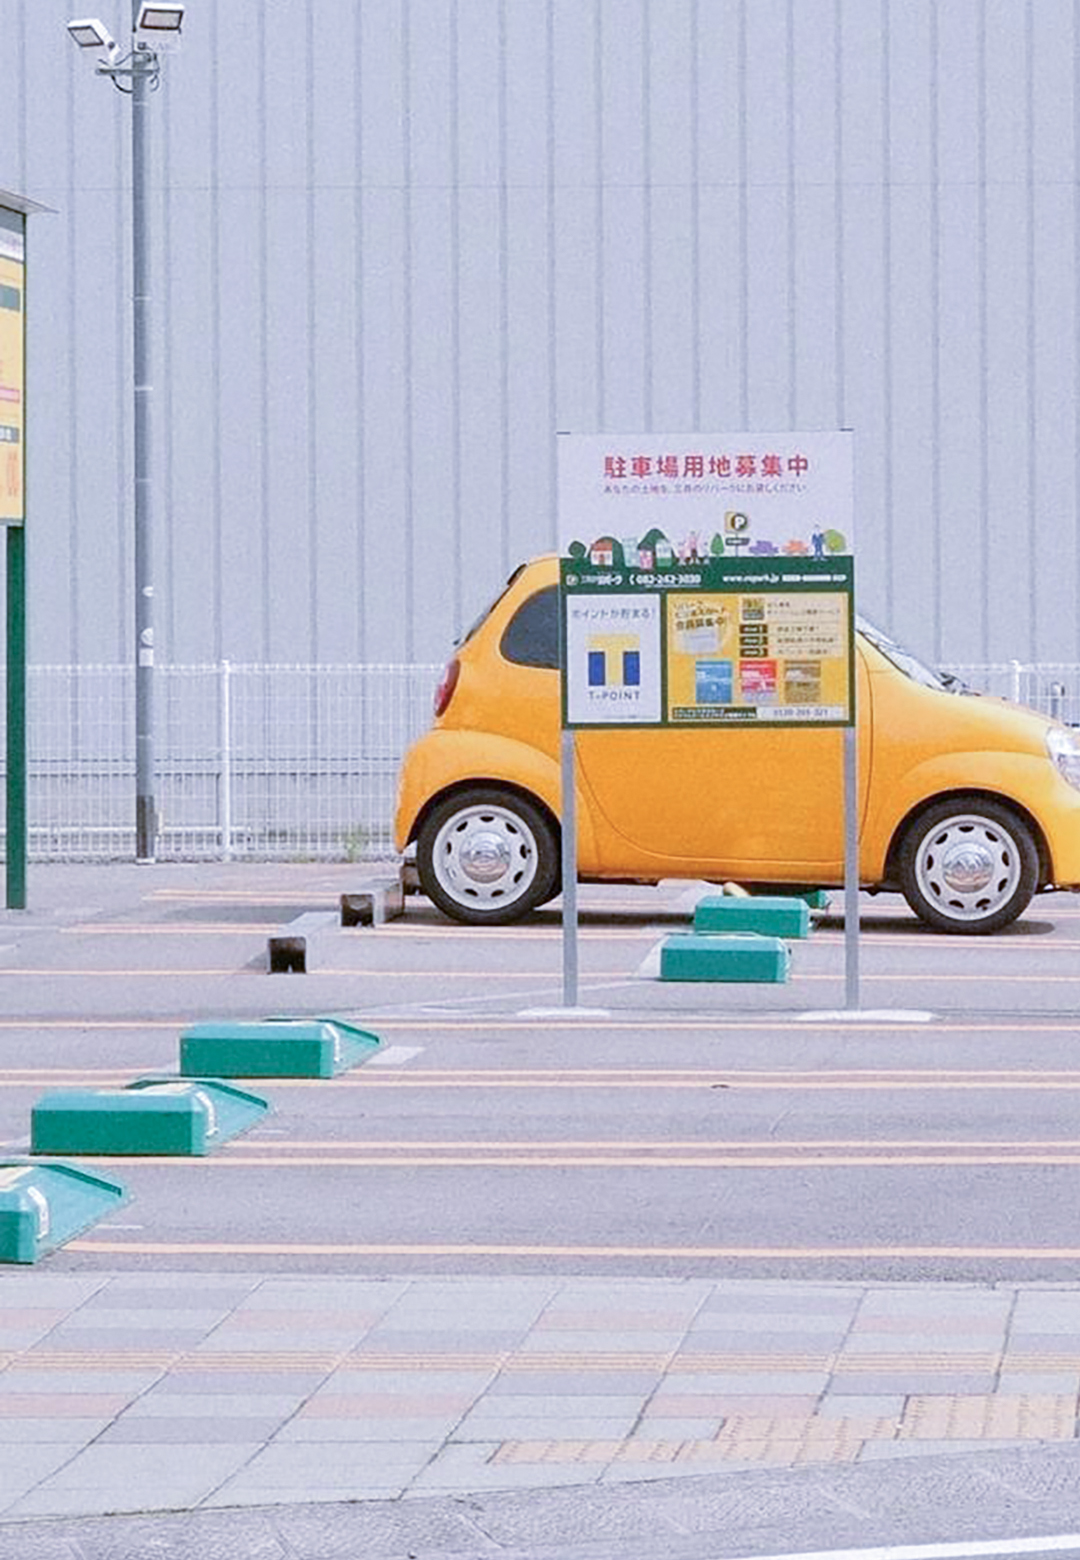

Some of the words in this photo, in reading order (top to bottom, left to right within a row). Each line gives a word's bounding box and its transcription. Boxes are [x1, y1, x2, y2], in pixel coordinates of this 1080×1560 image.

[604, 455, 809, 478] 駐車場用地募集中
